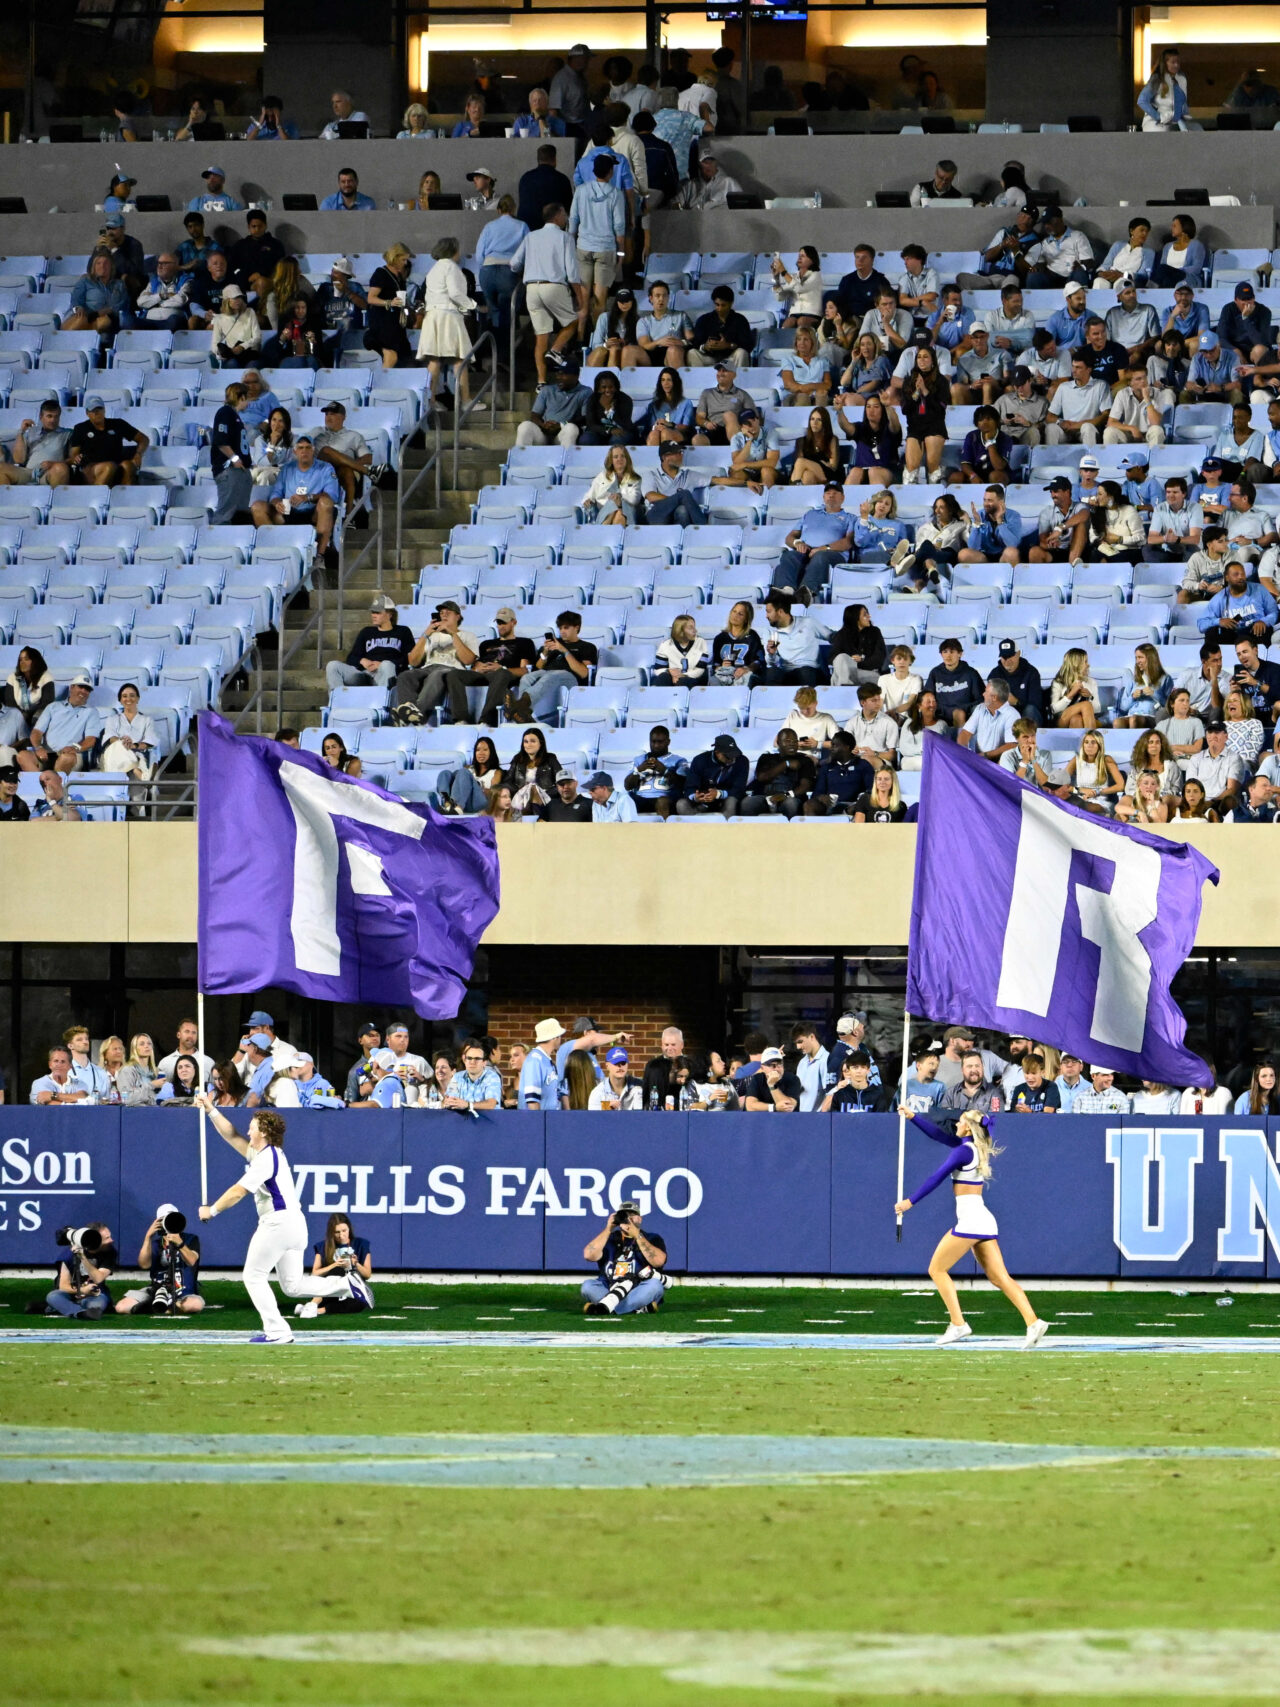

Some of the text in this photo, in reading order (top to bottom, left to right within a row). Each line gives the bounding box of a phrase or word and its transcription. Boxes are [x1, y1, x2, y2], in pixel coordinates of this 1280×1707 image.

[720, 643, 749, 665] 47
[279, 760, 427, 976] F
[996, 789, 1161, 1052] R
[2, 1138, 93, 1185] Son
[294, 1164, 703, 1218] ELLS FARGO
